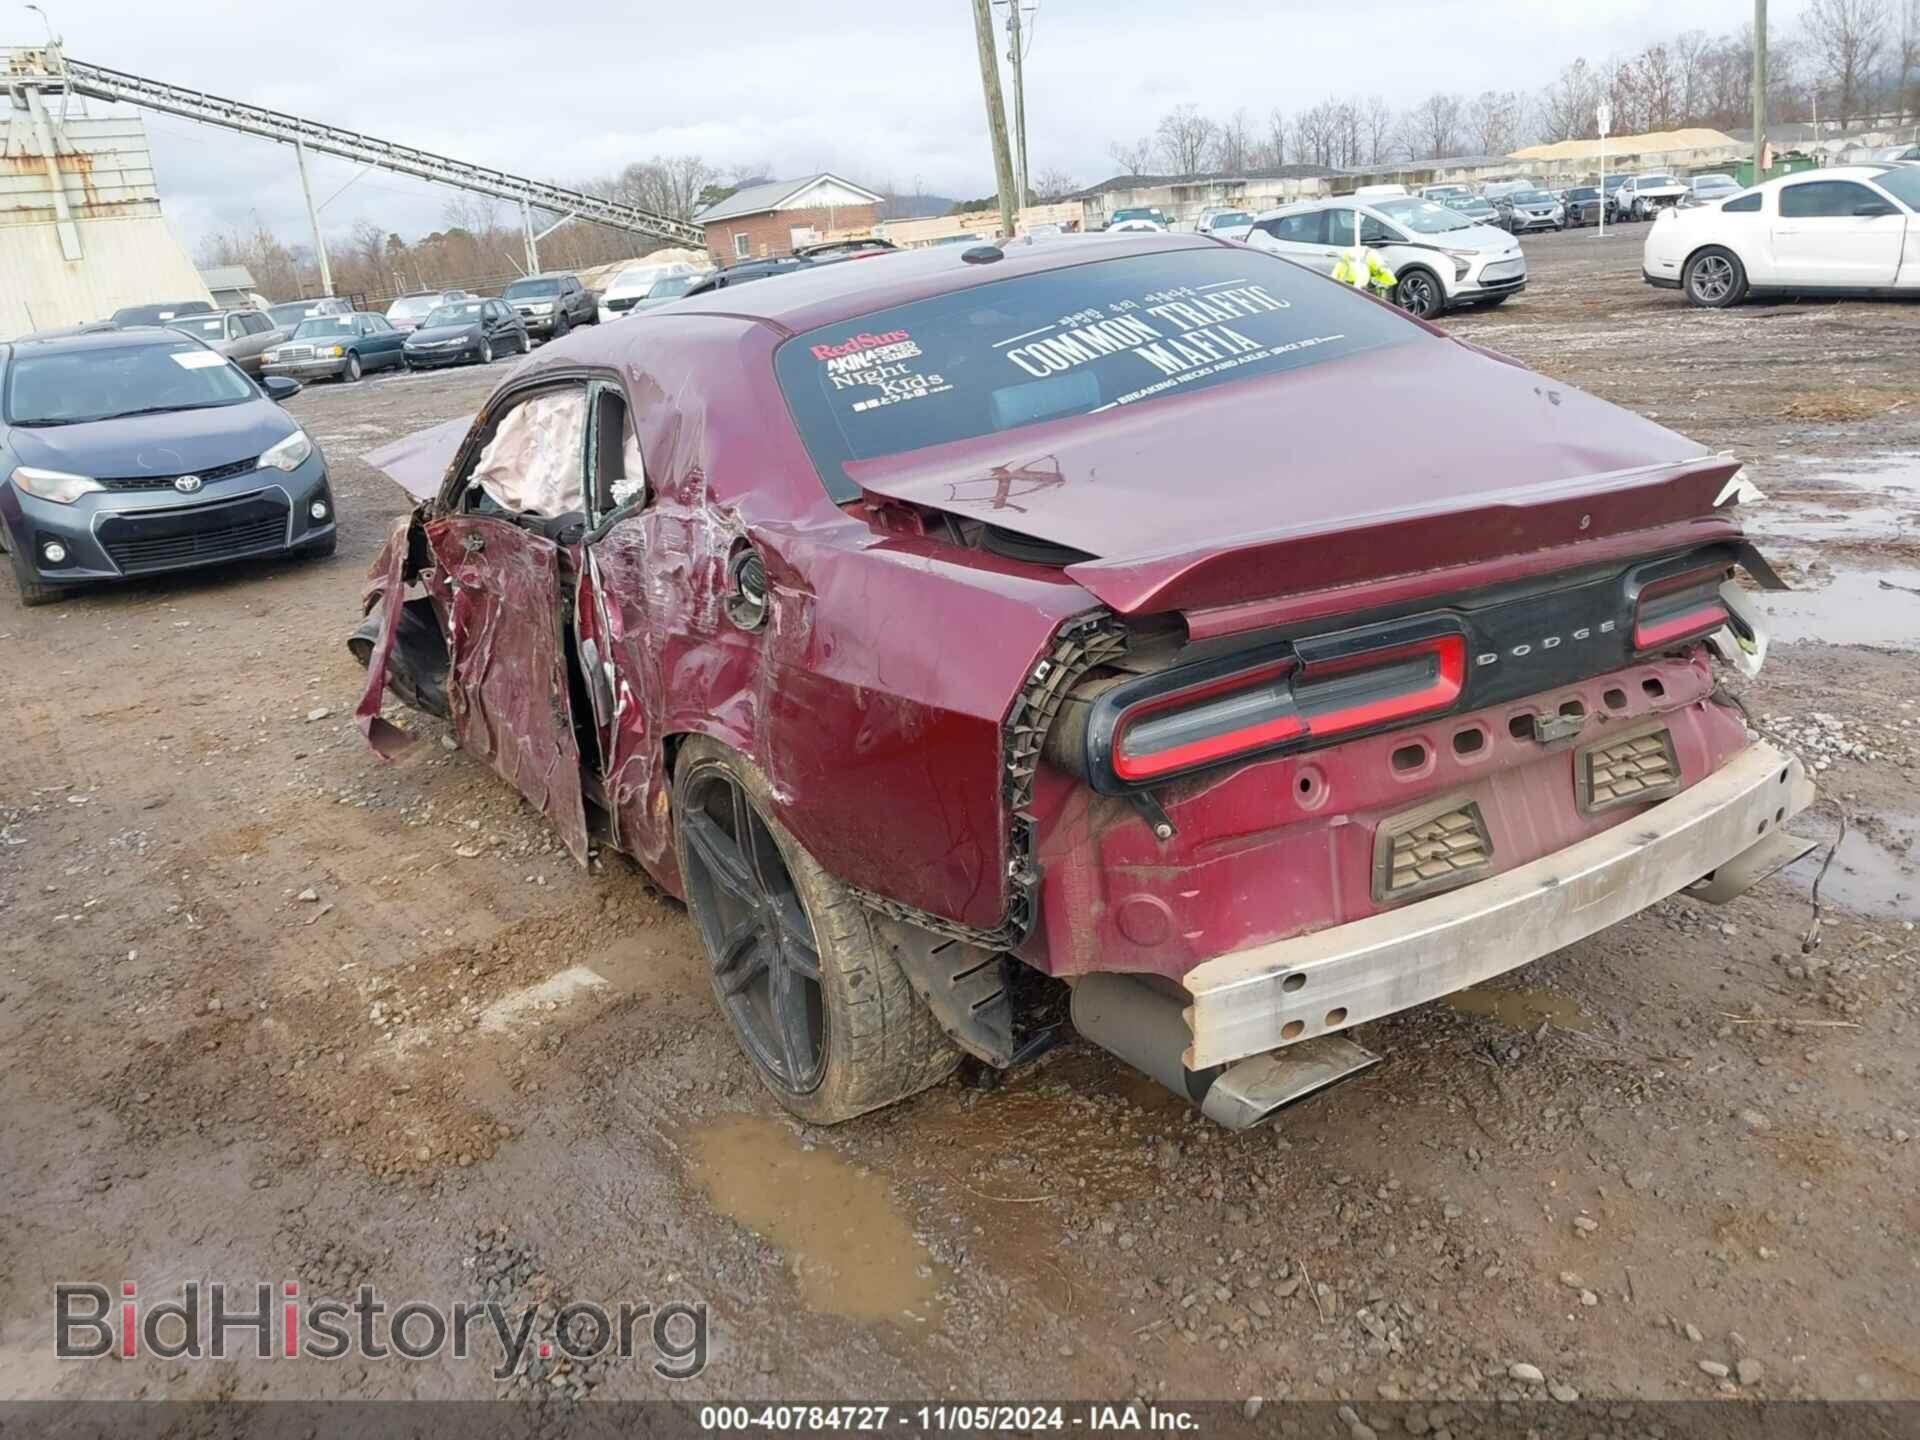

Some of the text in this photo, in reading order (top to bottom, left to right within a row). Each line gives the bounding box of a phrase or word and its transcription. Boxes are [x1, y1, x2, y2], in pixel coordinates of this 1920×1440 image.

[1007, 285, 1291, 377] COMMON TRAFFIC
[1132, 325, 1264, 376] MAFIA
[1116, 378, 1178, 405] BREAKING
[1476, 620, 1615, 666] DODGE
